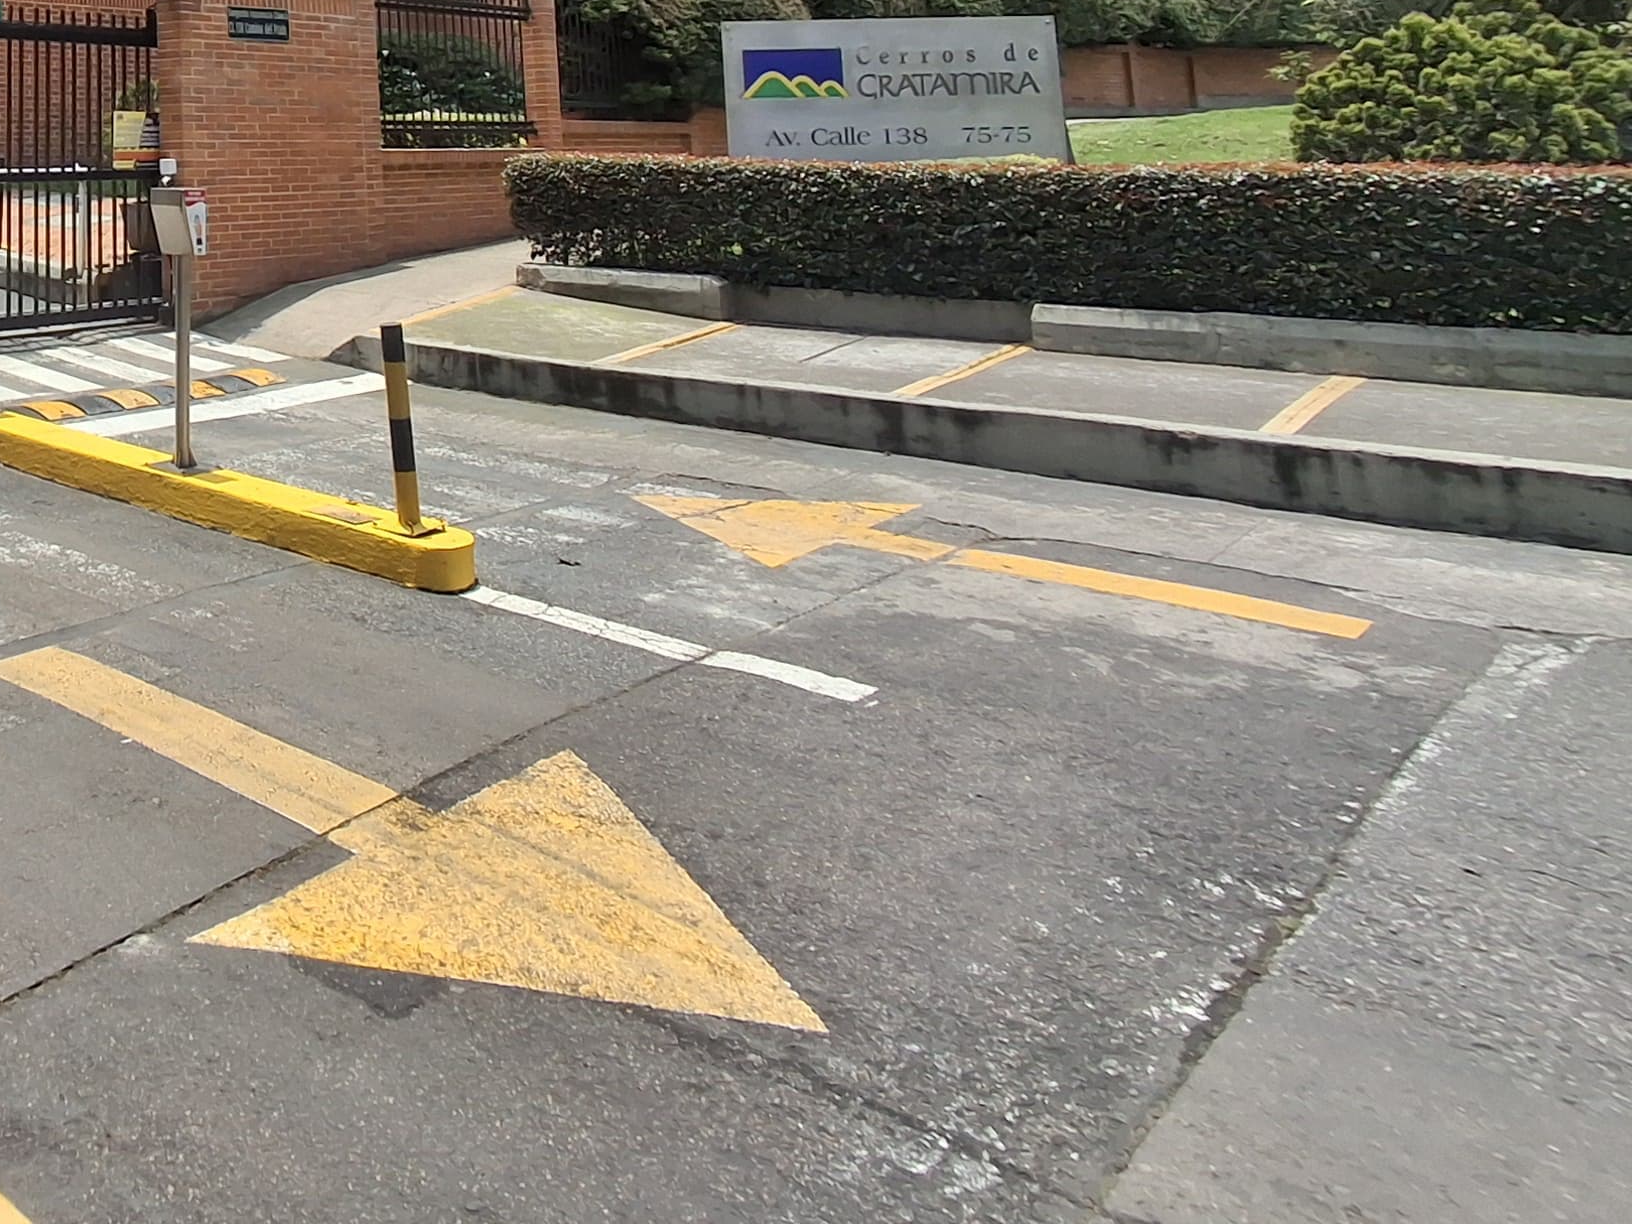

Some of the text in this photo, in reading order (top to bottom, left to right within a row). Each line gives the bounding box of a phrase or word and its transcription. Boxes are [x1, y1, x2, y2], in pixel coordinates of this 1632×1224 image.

[855, 42, 1039, 65] Cerros de
[856, 71, 1041, 100] GRATAMIRA
[765, 125, 1032, 147] Av. Calle 138 75-75
